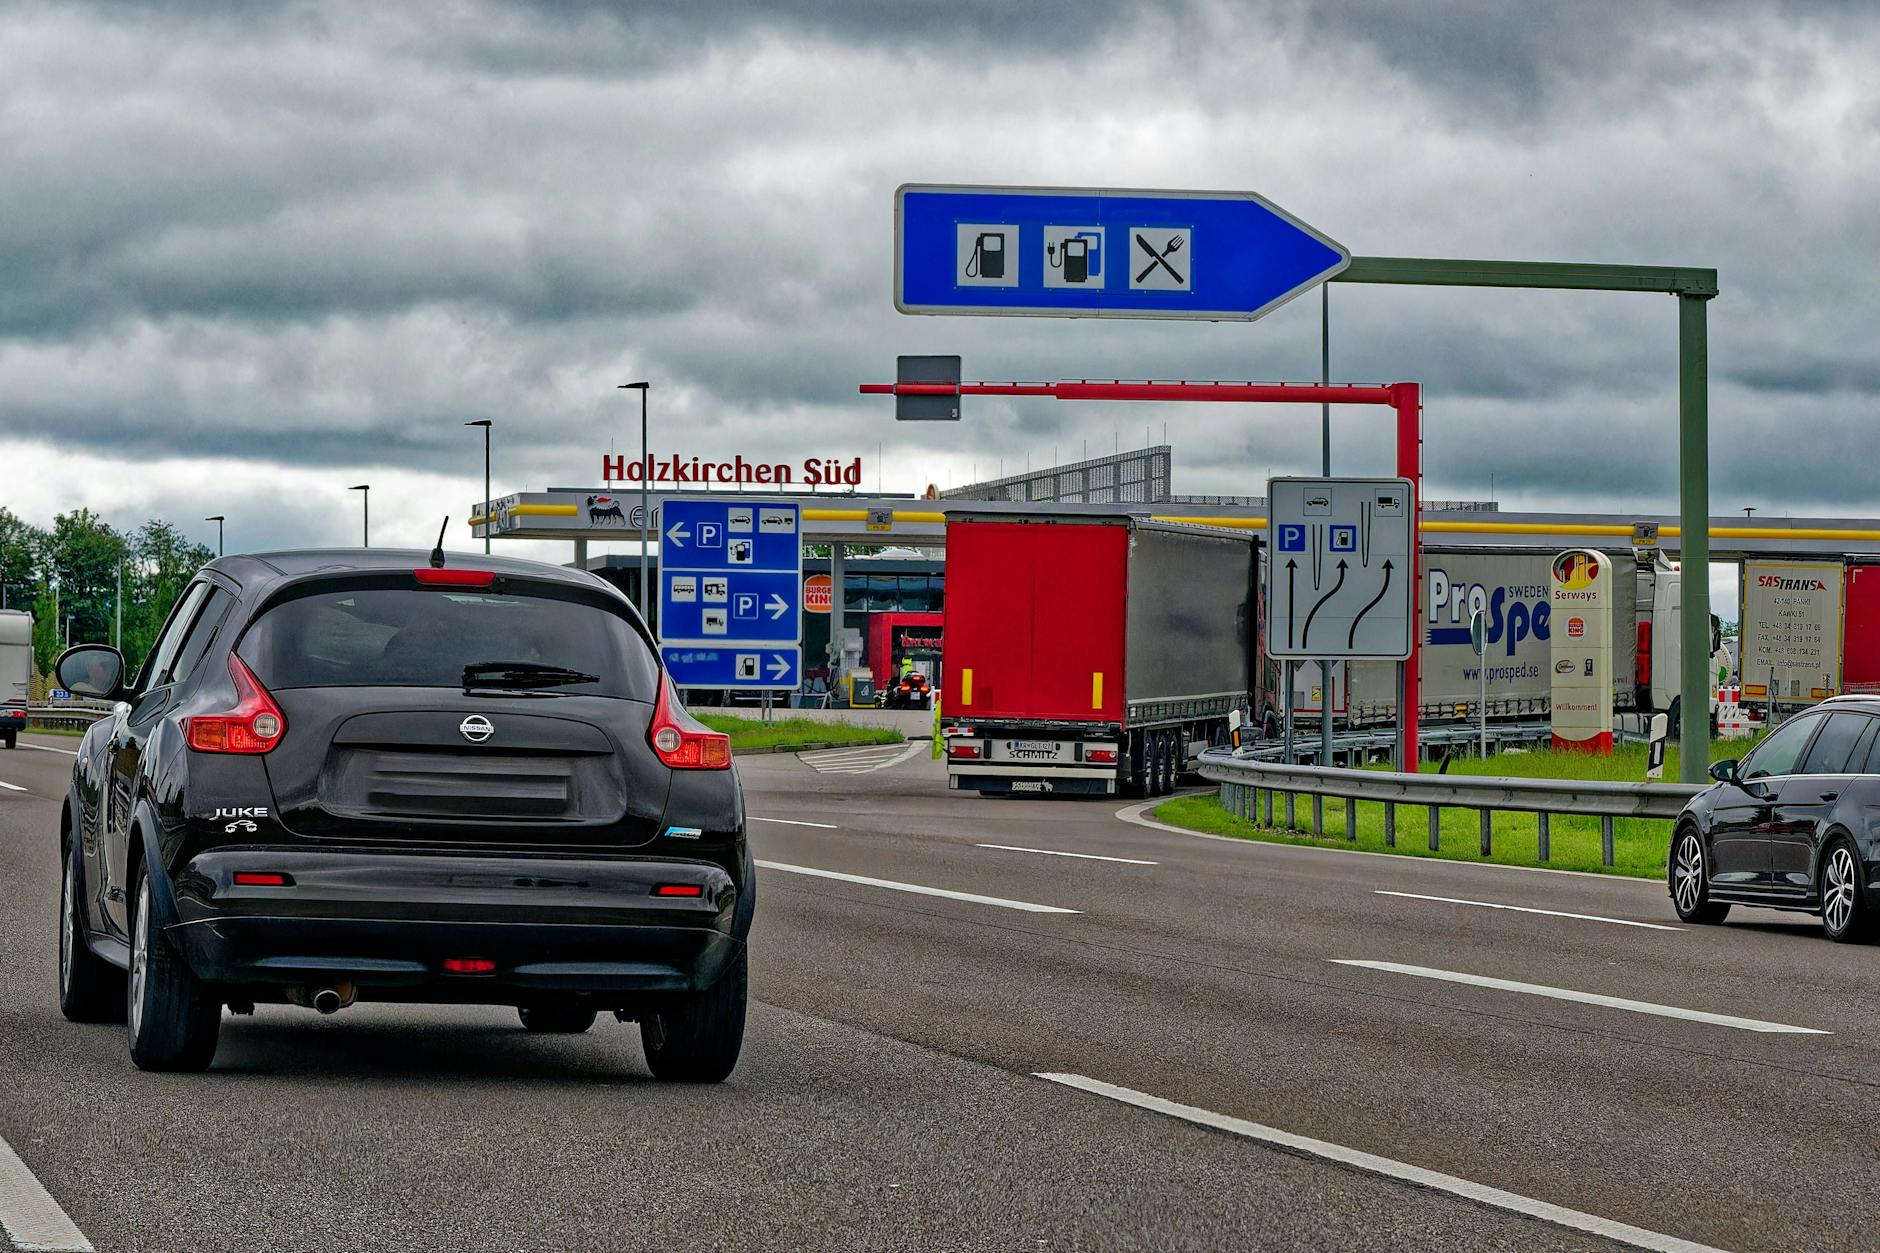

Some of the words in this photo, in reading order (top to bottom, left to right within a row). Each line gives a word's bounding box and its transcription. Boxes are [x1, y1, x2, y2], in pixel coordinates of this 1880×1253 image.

[603, 453, 792, 483] Holzkirchen
[803, 457, 862, 486] Süd
[702, 525, 717, 544] P
[1284, 527, 1300, 548] P
[805, 586, 832, 594] BURGE
[1757, 575, 1818, 591] SASTRANS
[805, 593, 832, 604] KIN
[1508, 586, 1549, 598] SWEDEN
[1555, 590, 1597, 601] Serways
[739, 596, 753, 616] P
[1428, 568, 1552, 657] ProSpe
[1009, 750, 1058, 760] SCHMITZ
[209, 807, 268, 820] JUKE
